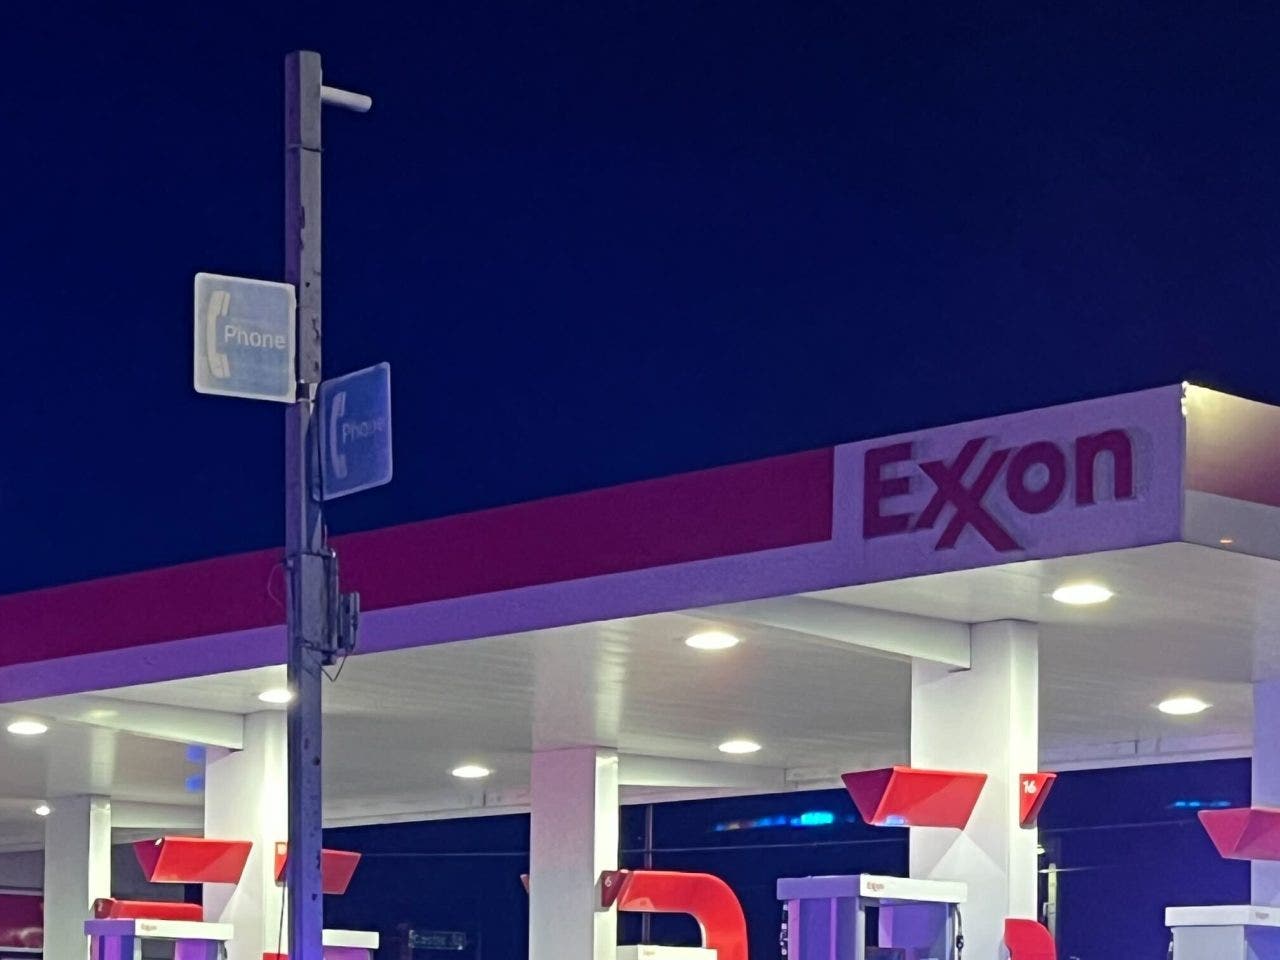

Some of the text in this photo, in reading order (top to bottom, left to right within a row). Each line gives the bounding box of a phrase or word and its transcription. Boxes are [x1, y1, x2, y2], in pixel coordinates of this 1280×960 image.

[224, 325, 288, 350] Phone
[863, 428, 1134, 551] Exxon
[1023, 780, 1037, 793] 16
